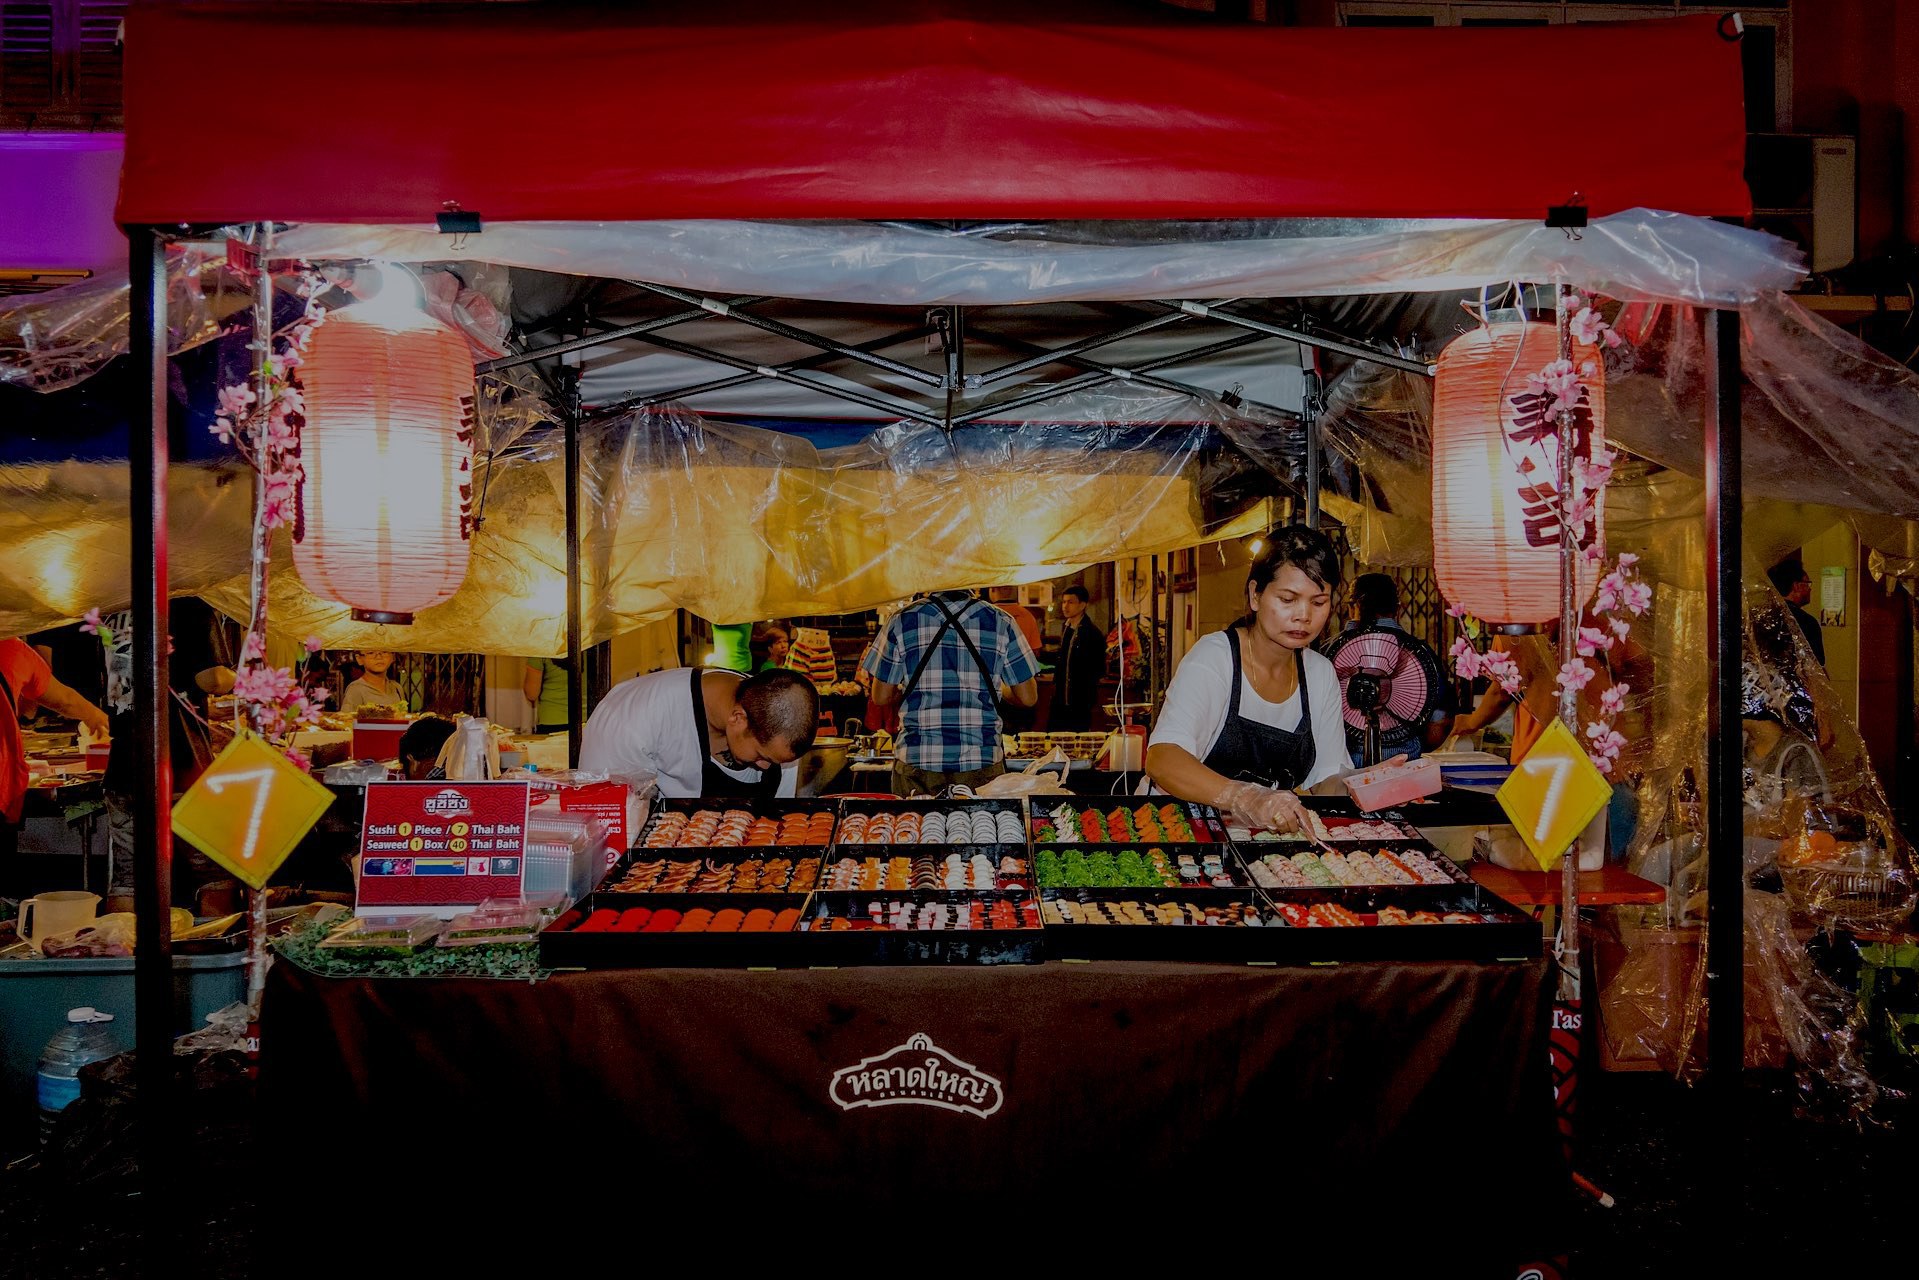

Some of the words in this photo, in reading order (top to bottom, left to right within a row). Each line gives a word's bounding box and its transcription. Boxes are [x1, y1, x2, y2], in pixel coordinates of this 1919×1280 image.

[206, 767, 275, 859] 7
[1521, 757, 1572, 841] 7
[366, 839, 409, 849] Seaweed
[452, 841, 465, 849] 40
[470, 839, 493, 849] Thai
[496, 839, 519, 849] Baht
[368, 824, 397, 835] Sushi
[414, 824, 442, 835] Piece
[471, 824, 495, 835] Thai
[497, 824, 520, 835] Baht
[846, 1058, 990, 1103] หลาดใหญ่
